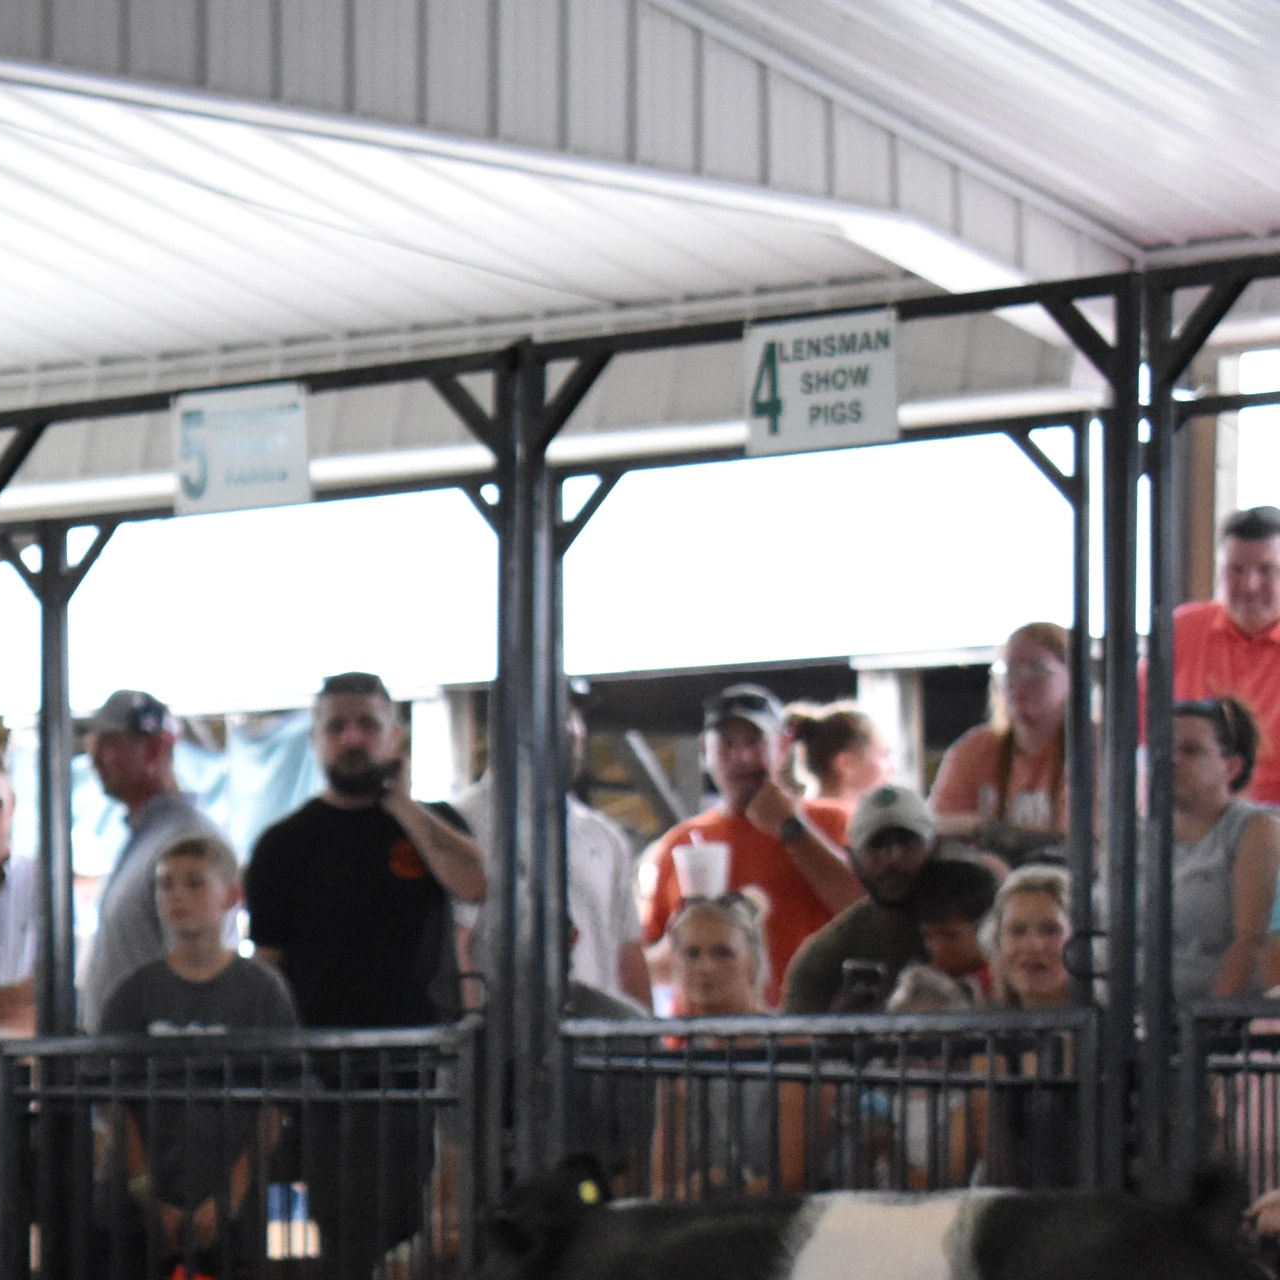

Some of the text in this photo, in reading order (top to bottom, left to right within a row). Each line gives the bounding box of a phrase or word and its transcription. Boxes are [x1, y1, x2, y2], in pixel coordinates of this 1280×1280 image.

[778, 329, 890, 362] LENSMAN
[752, 340, 783, 435] 4
[800, 365, 869, 394] SHOW
[809, 401, 862, 426] PIGS
[181, 408, 208, 501] 5
